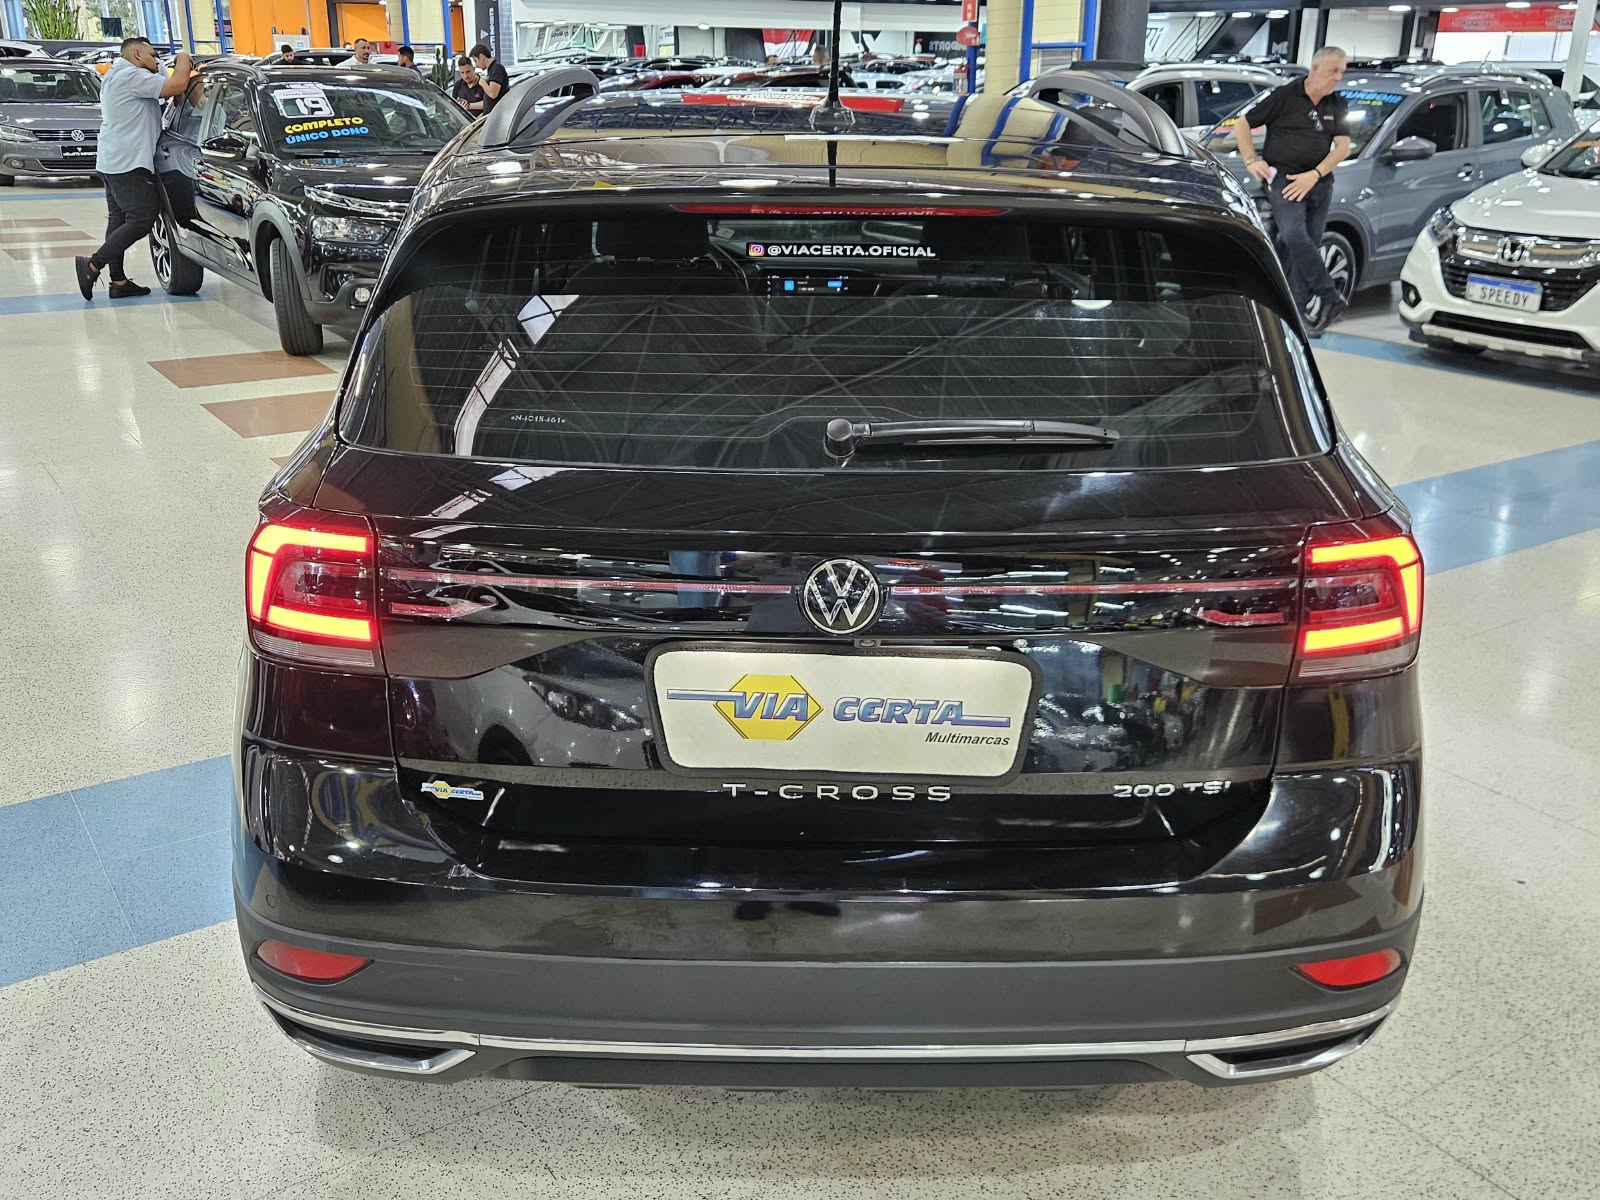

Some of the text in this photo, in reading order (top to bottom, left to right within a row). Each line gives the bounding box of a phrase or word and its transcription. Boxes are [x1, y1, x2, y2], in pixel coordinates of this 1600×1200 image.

[284, 116, 364, 134] COMPLETO
[285, 126, 369, 144] ÚNICO DONO
[767, 244, 936, 257] @VIACERTA.OFICIAL
[1479, 286, 1529, 306] SPEEDY
[733, 692, 963, 726] VIA CERTA
[925, 731, 1011, 746] Multimarcas
[722, 783, 951, 801] T-CROSS
[1113, 780, 1232, 797] 200 TSI
